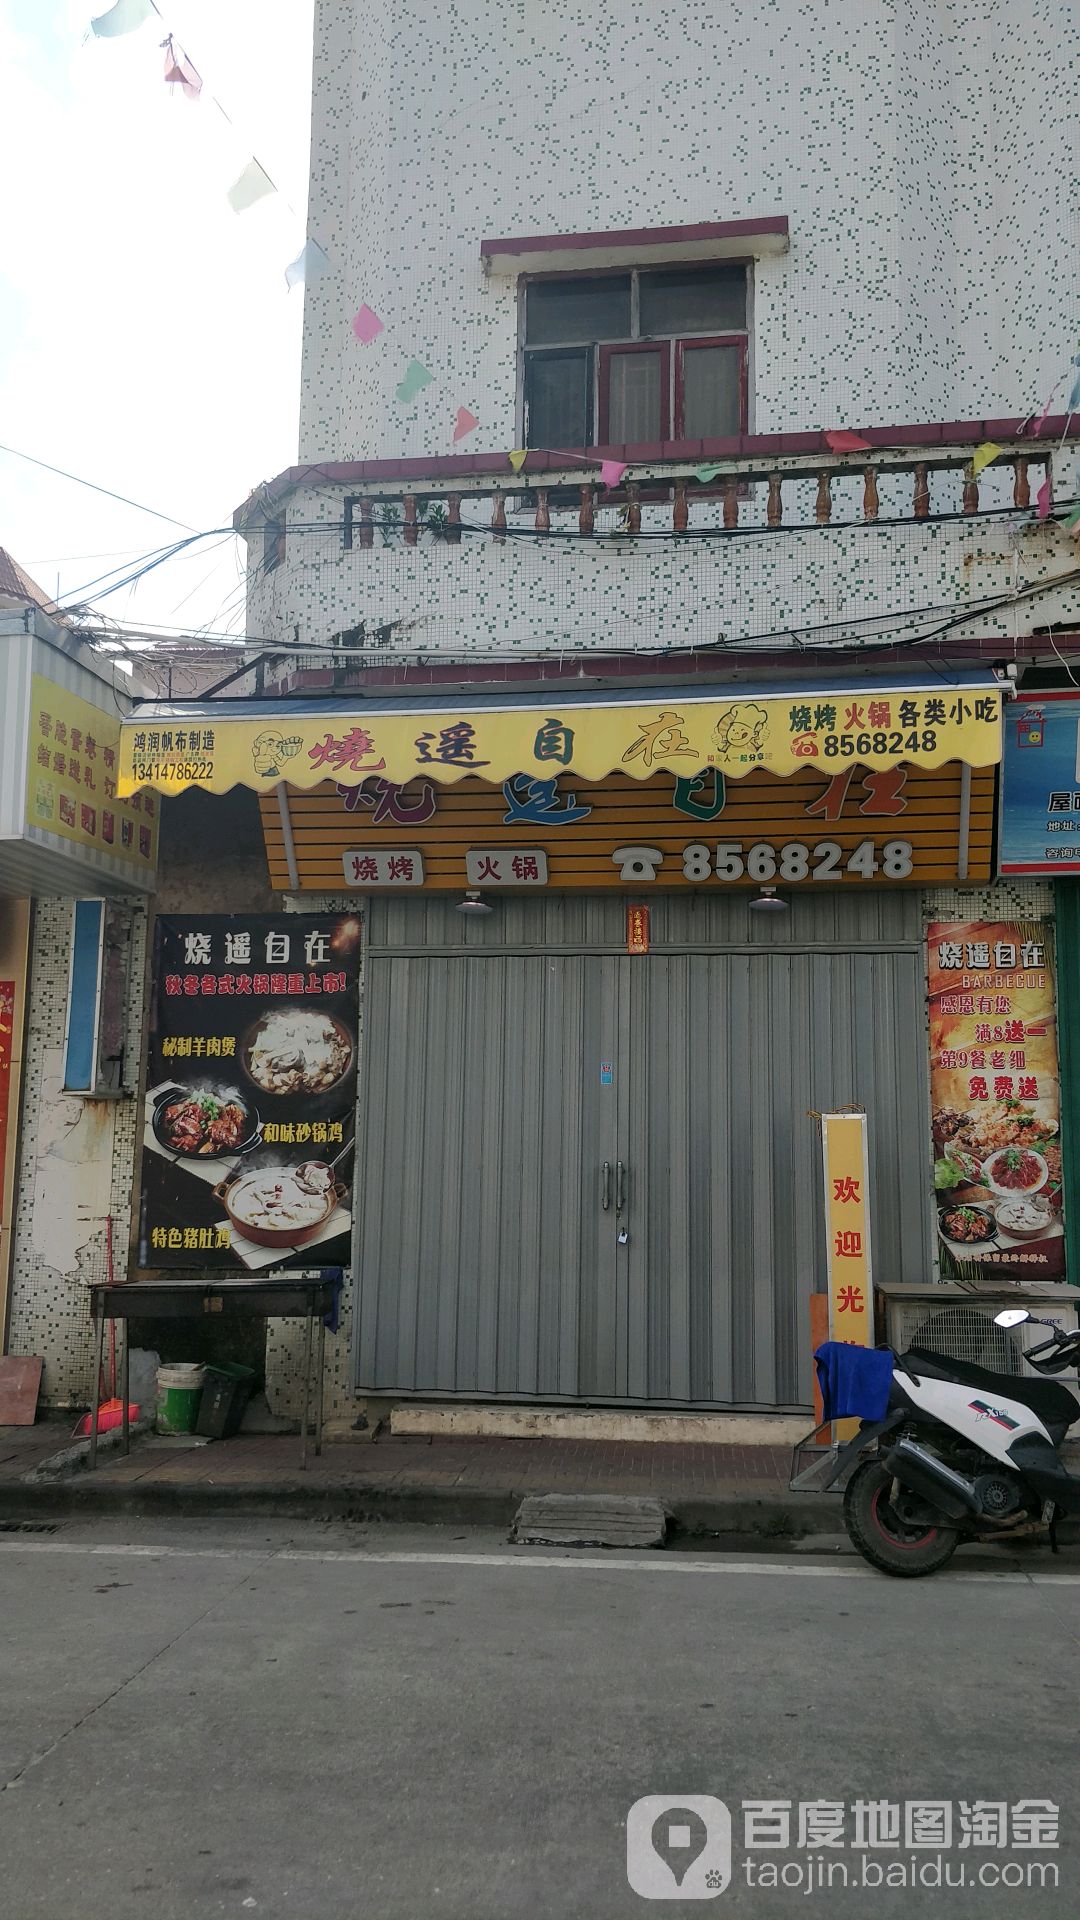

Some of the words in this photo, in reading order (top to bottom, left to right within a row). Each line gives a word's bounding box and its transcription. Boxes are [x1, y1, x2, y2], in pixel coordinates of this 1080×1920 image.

[789, 704, 837, 733] 烧烤
[843, 701, 892, 730] 火锅
[898, 697, 999, 729] 各类小吃
[133, 730, 215, 752] 鸿润帆布制造
[824, 730, 937, 758] 8568248
[132, 762, 214, 781] 13414786222
[351, 856, 414, 881] 烧烤
[477, 856, 539, 880] 火锅
[683, 841, 914, 881] 8568248
[184, 930, 332, 965] 烧遥自在
[938, 941, 1045, 969] 烧遥自在
[962, 974, 1046, 989] BARBECUE
[940, 995, 1011, 1015] 感恩有您
[974, 1020, 1047, 1043] 满8送一
[162, 1036, 236, 1057] 秘制羊肉煲
[940, 1050, 1026, 1070] 第9餐老细
[969, 1076, 1040, 1101] 免费送
[263, 1122, 343, 1144] 和味砂锅鸡
[152, 1227, 232, 1249] 特色猪肚鸡
[833, 1176, 865, 1349] 欢迎光
